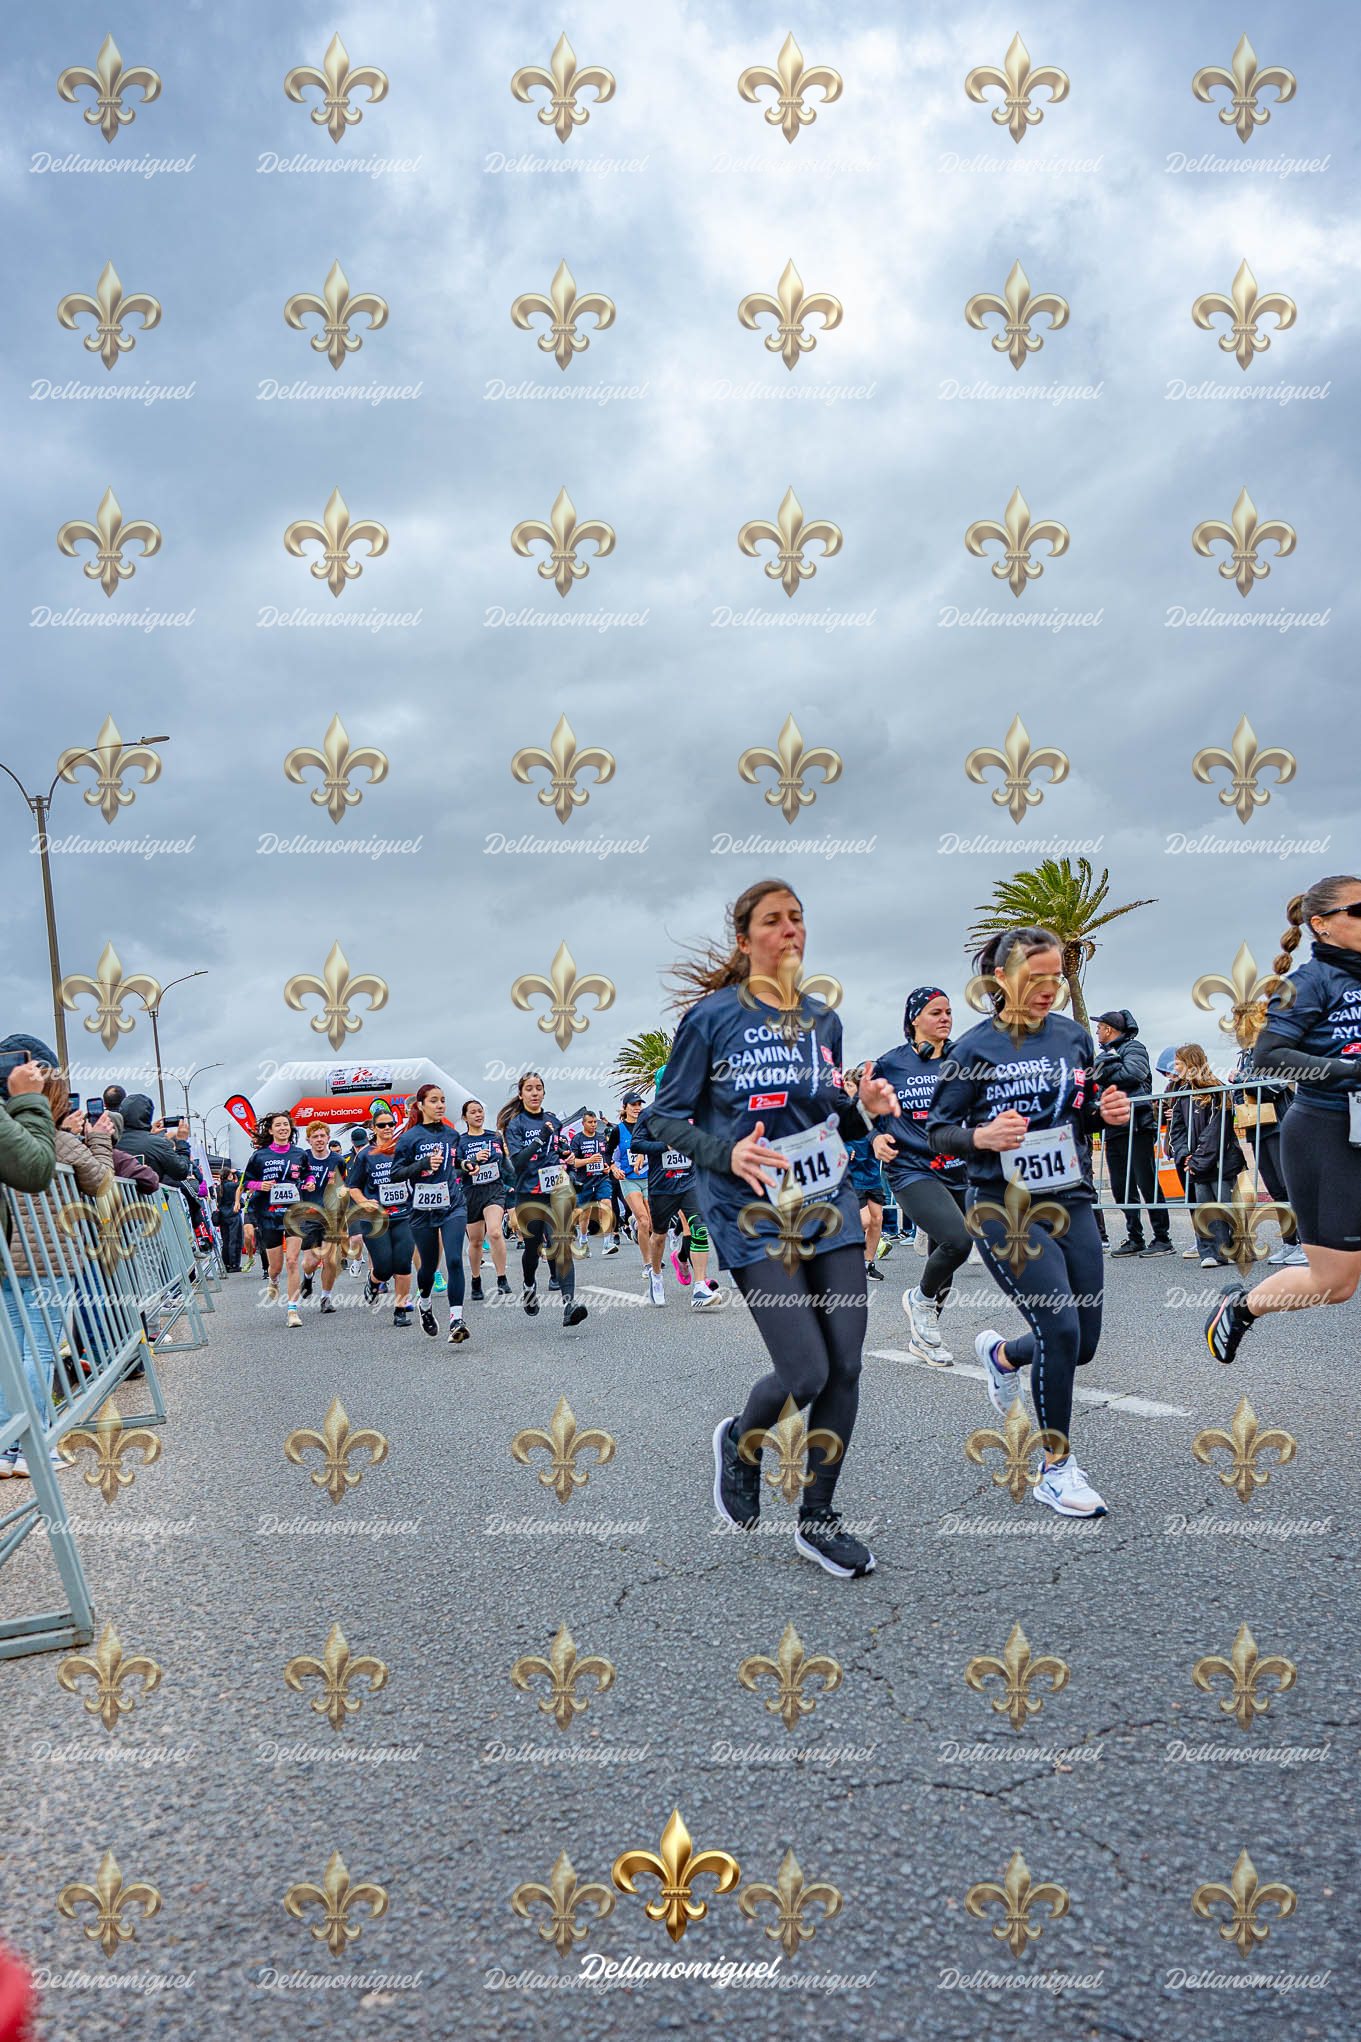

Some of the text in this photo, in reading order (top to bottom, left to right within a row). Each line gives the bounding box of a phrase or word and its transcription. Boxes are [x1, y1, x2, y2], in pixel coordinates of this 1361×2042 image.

[995, 1057, 1053, 1080] CORRÉ
[907, 1075, 938, 1085] CORR
[898, 1087, 935, 1099] CAMIN
[902, 1099, 931, 1110] AYUD
[330, 1108, 363, 1116] balance
[1014, 1150, 1066, 1181] 2514
[274, 1190, 294, 1199] 2445
[384, 1191, 404, 1201] 2566
[418, 1193, 442, 1204] 2826
